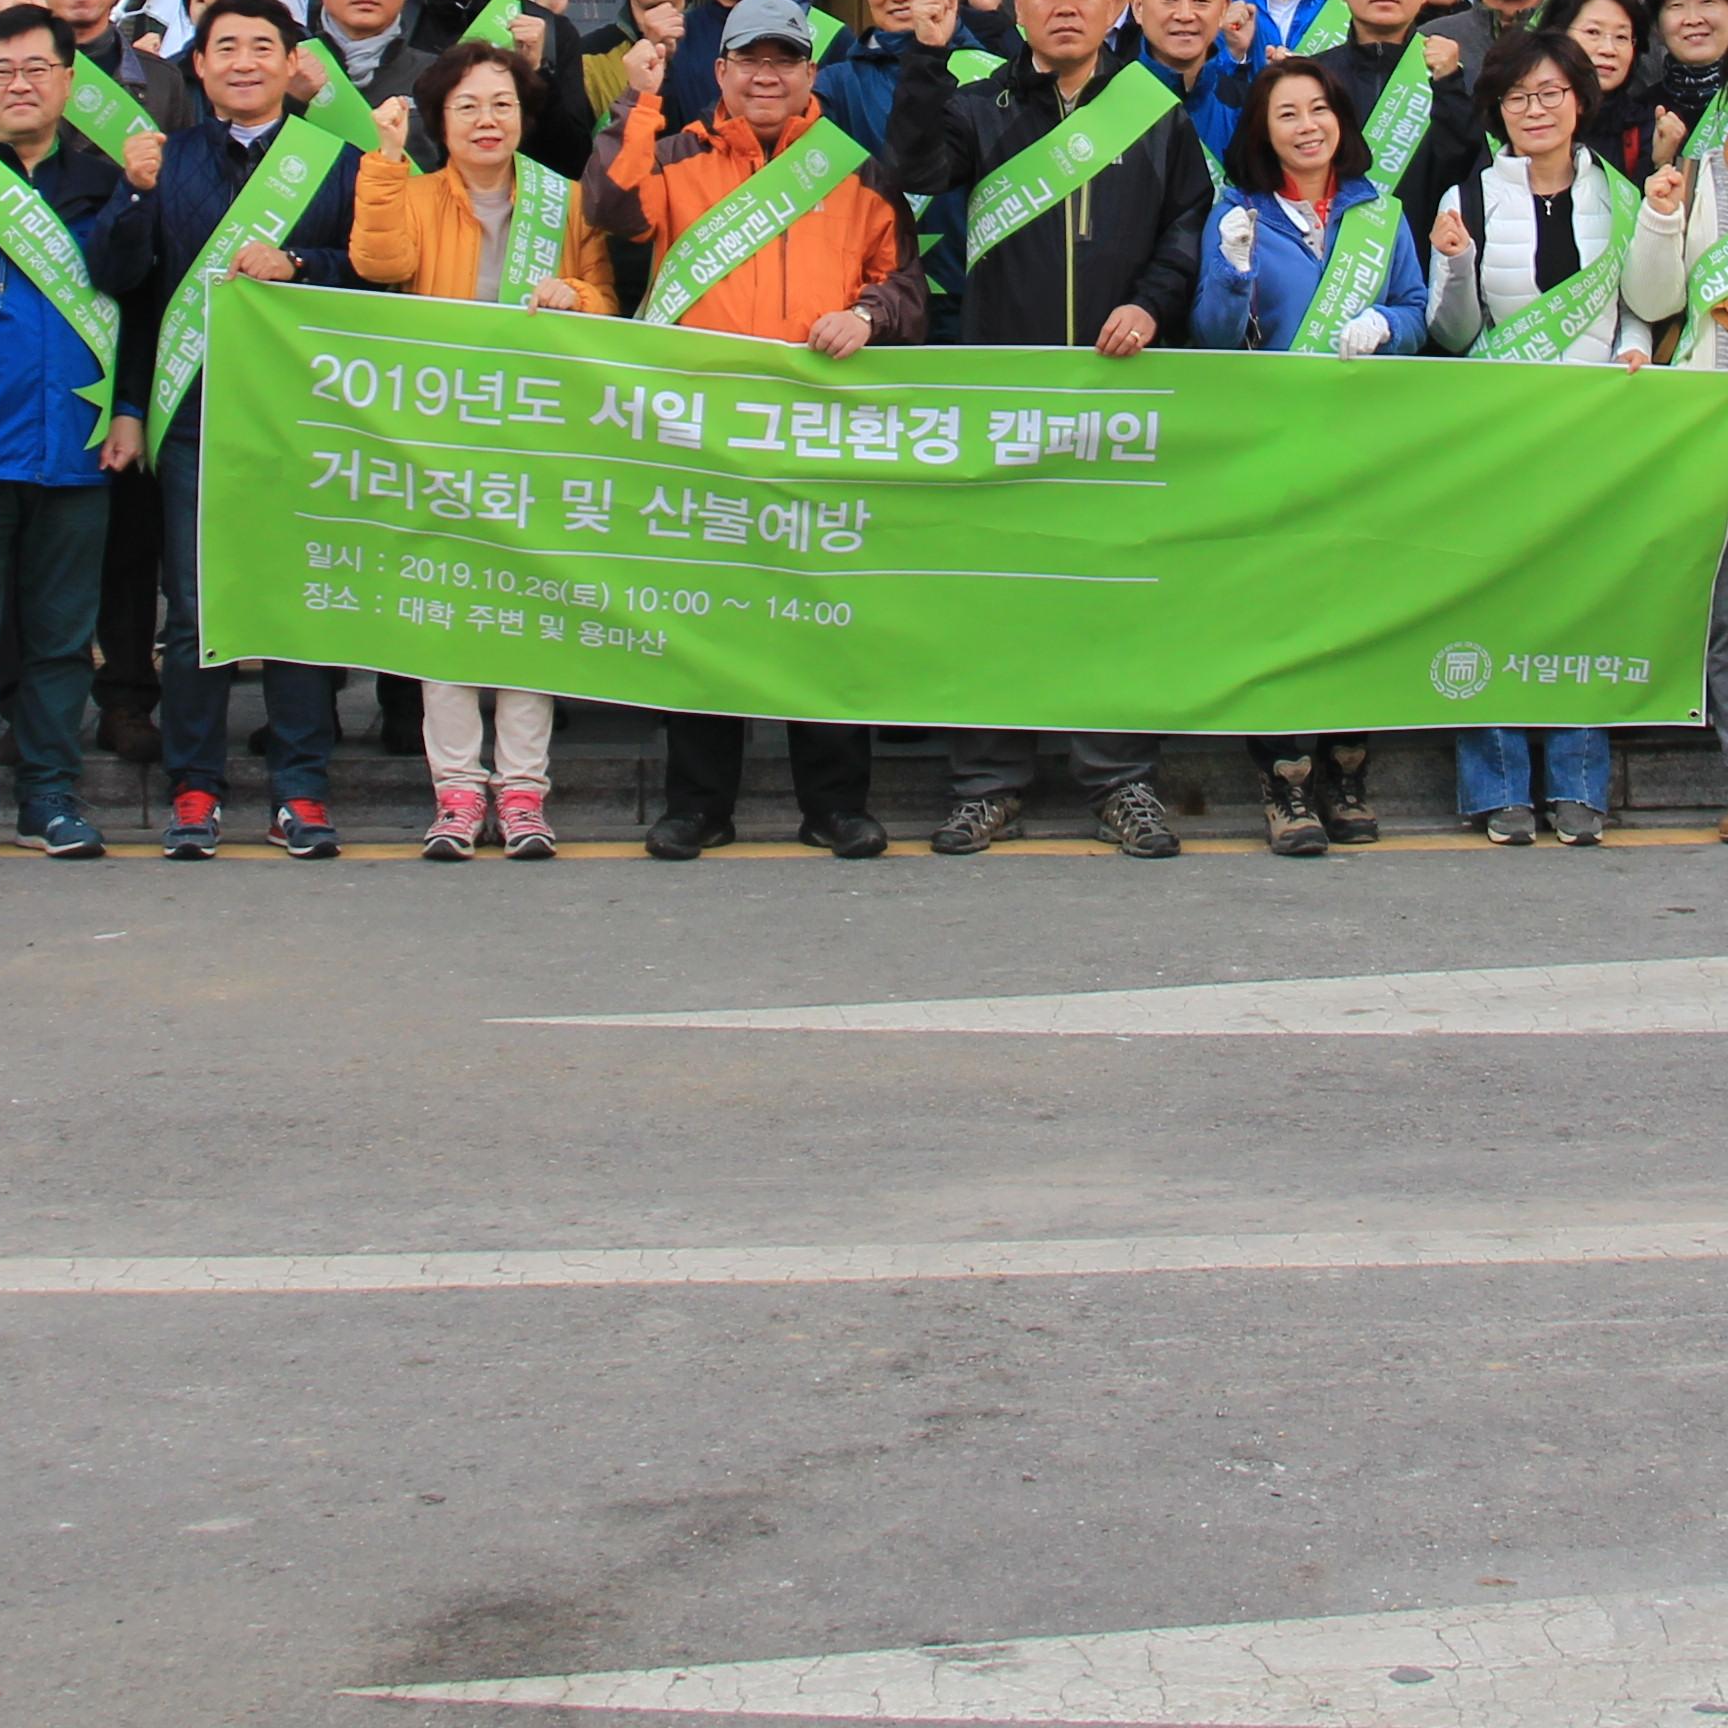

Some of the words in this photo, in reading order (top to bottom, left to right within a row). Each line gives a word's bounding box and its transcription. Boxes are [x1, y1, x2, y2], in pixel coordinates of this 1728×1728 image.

[1369, 83, 1409, 142] 거리정화
[689, 191, 797, 285] 그린환경
[693, 191, 758, 245] 거리정화
[1316, 251, 1354, 318] 거리정화
[309, 353, 566, 426] 2019년도
[589, 384, 707, 450] 서일
[727, 401, 962, 465] 그린환경
[986, 408, 1160, 466] 캠페인
[309, 448, 536, 529] 거리정화
[561, 478, 614, 534] 및
[639, 486, 872, 554] 산불예방
[302, 581, 361, 613] 장소
[397, 595, 456, 632] 대학
[465, 604, 525, 639] 주변
[538, 613, 566, 642] 및
[577, 619, 668, 658] 용마산
[305, 541, 363, 573] 일시
[399, 553, 610, 612] 2019.10.26(토)
[623, 586, 711, 616] 10:00
[766, 595, 853, 628] 14:00
[1501, 653, 1651, 685] 서일대학교
